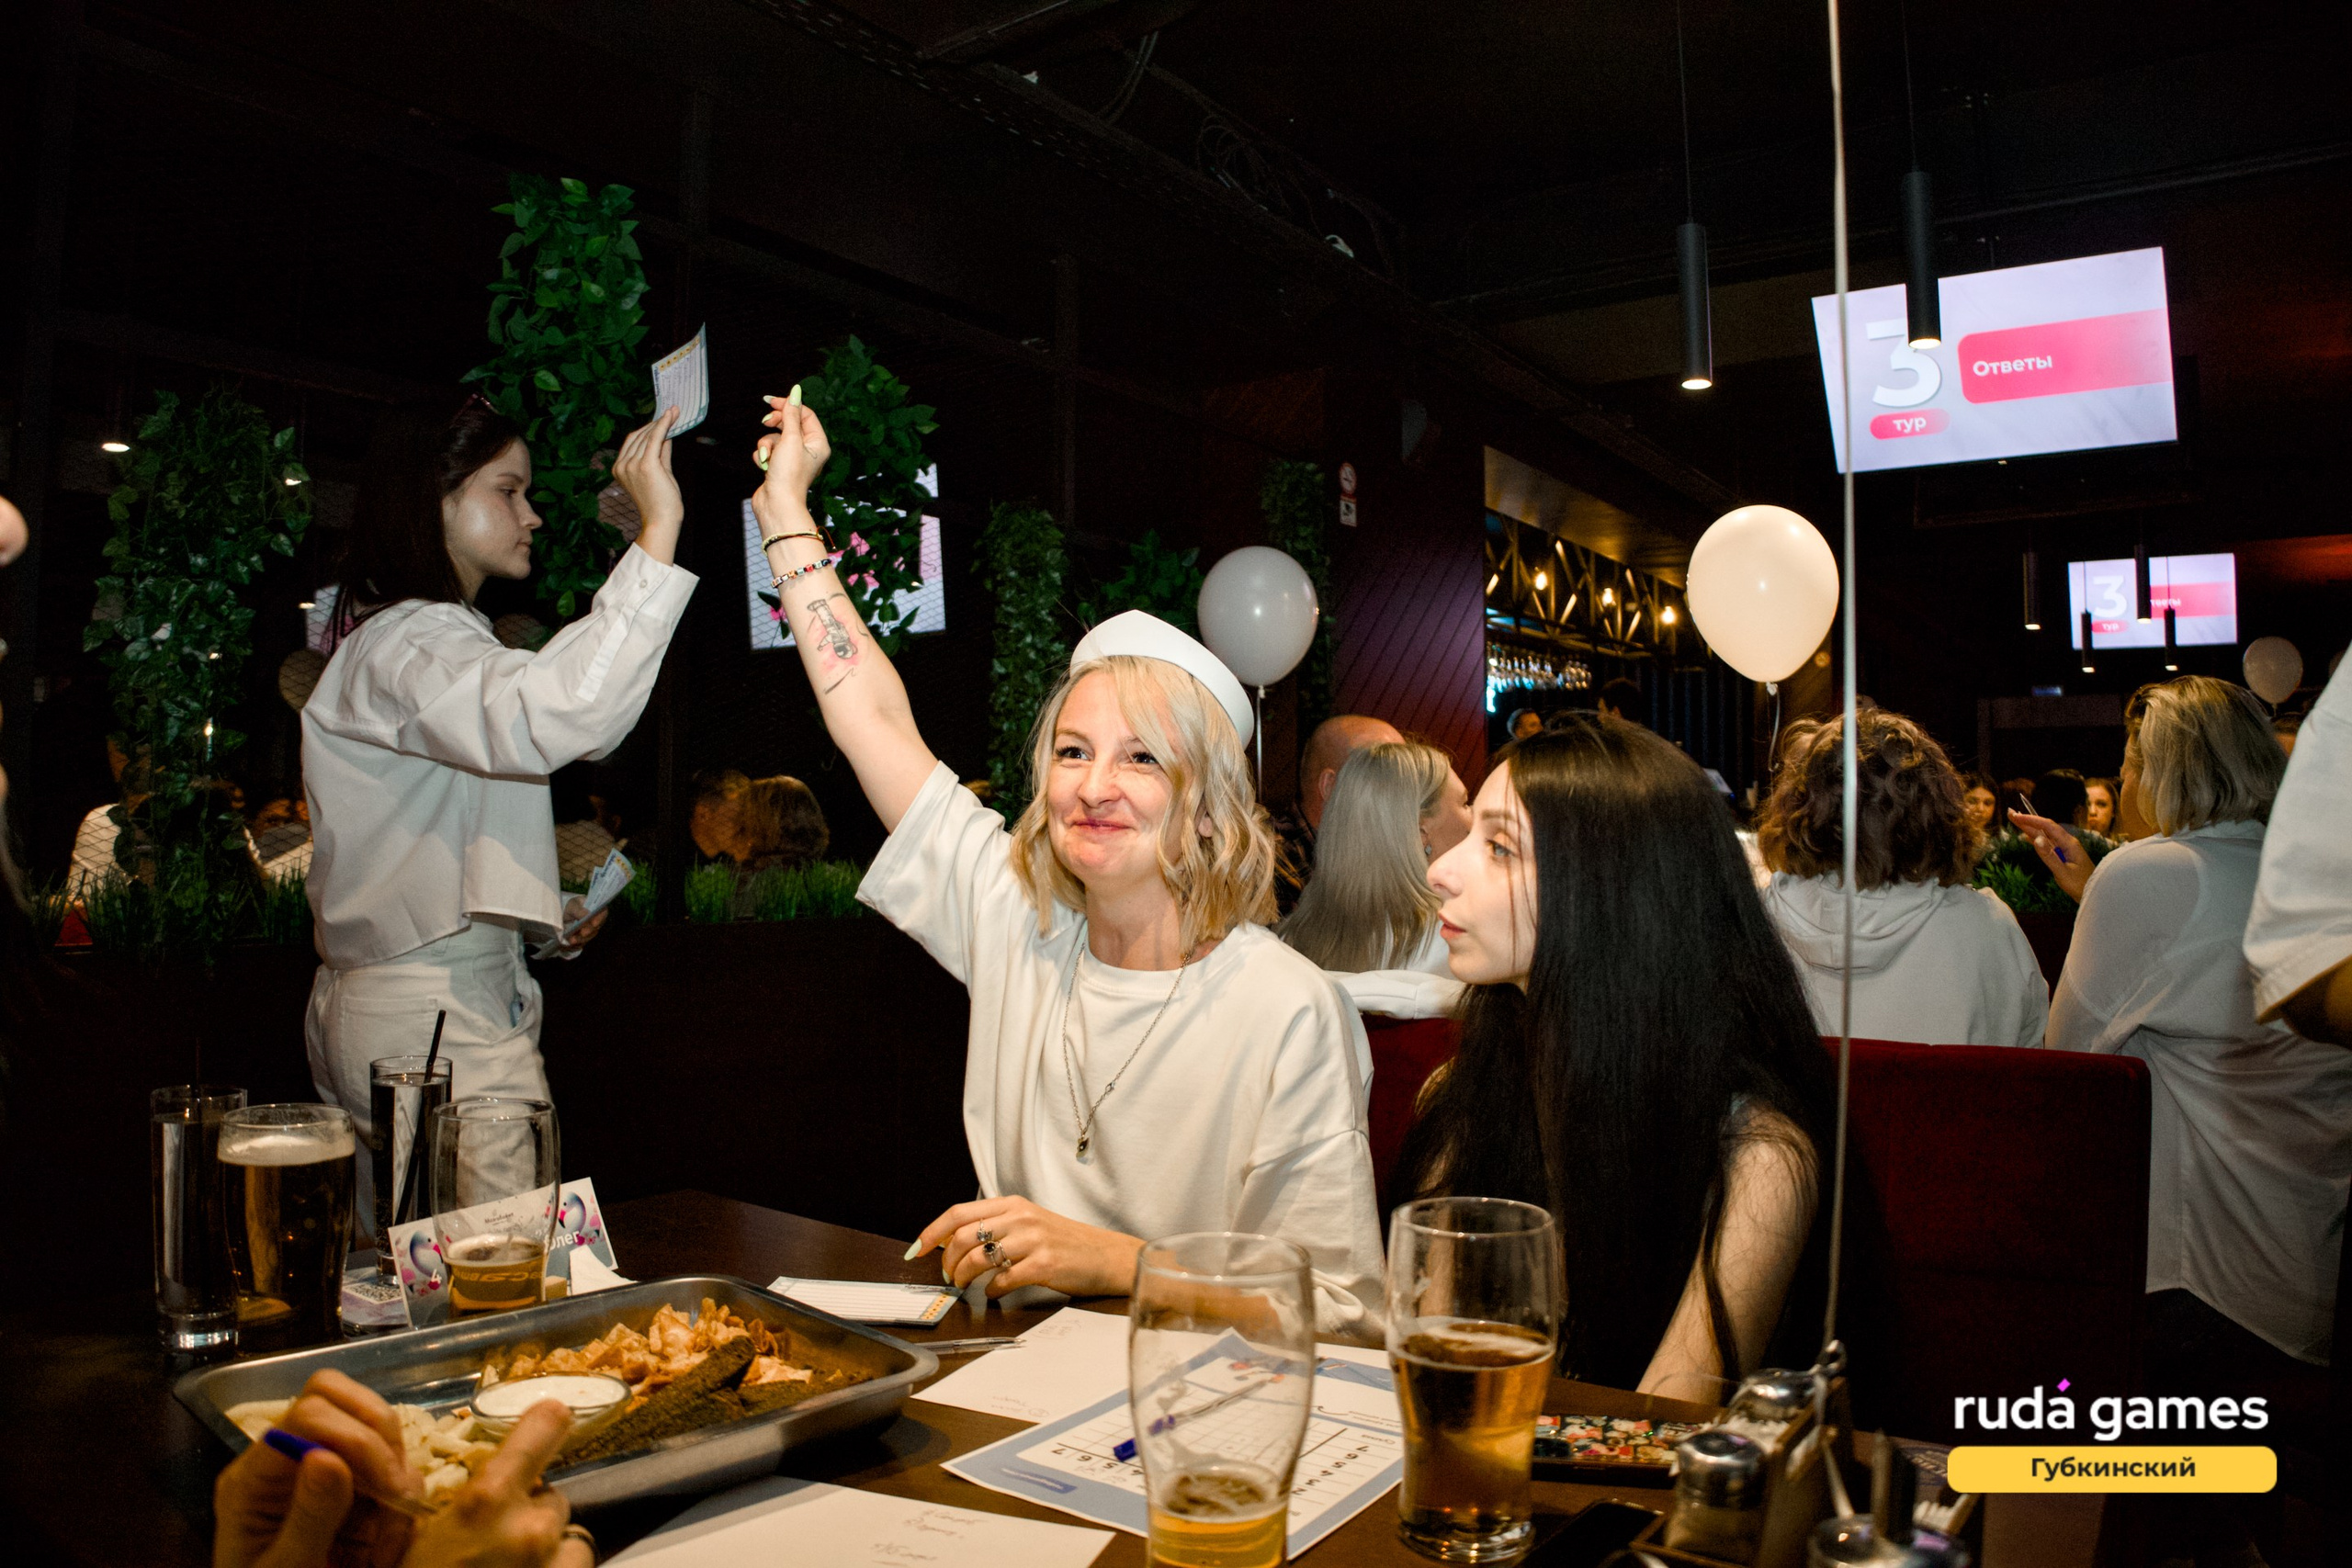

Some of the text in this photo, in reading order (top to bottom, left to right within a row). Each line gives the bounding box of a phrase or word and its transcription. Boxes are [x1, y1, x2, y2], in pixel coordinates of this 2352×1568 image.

[1866, 317, 1942, 407] 3
[1973, 354, 2052, 377] Ответы
[1893, 416, 1927, 434] тур
[2093, 575, 2128, 618] 3
[2150, 598, 2181, 607] тветы
[2102, 622, 2120, 631] тур
